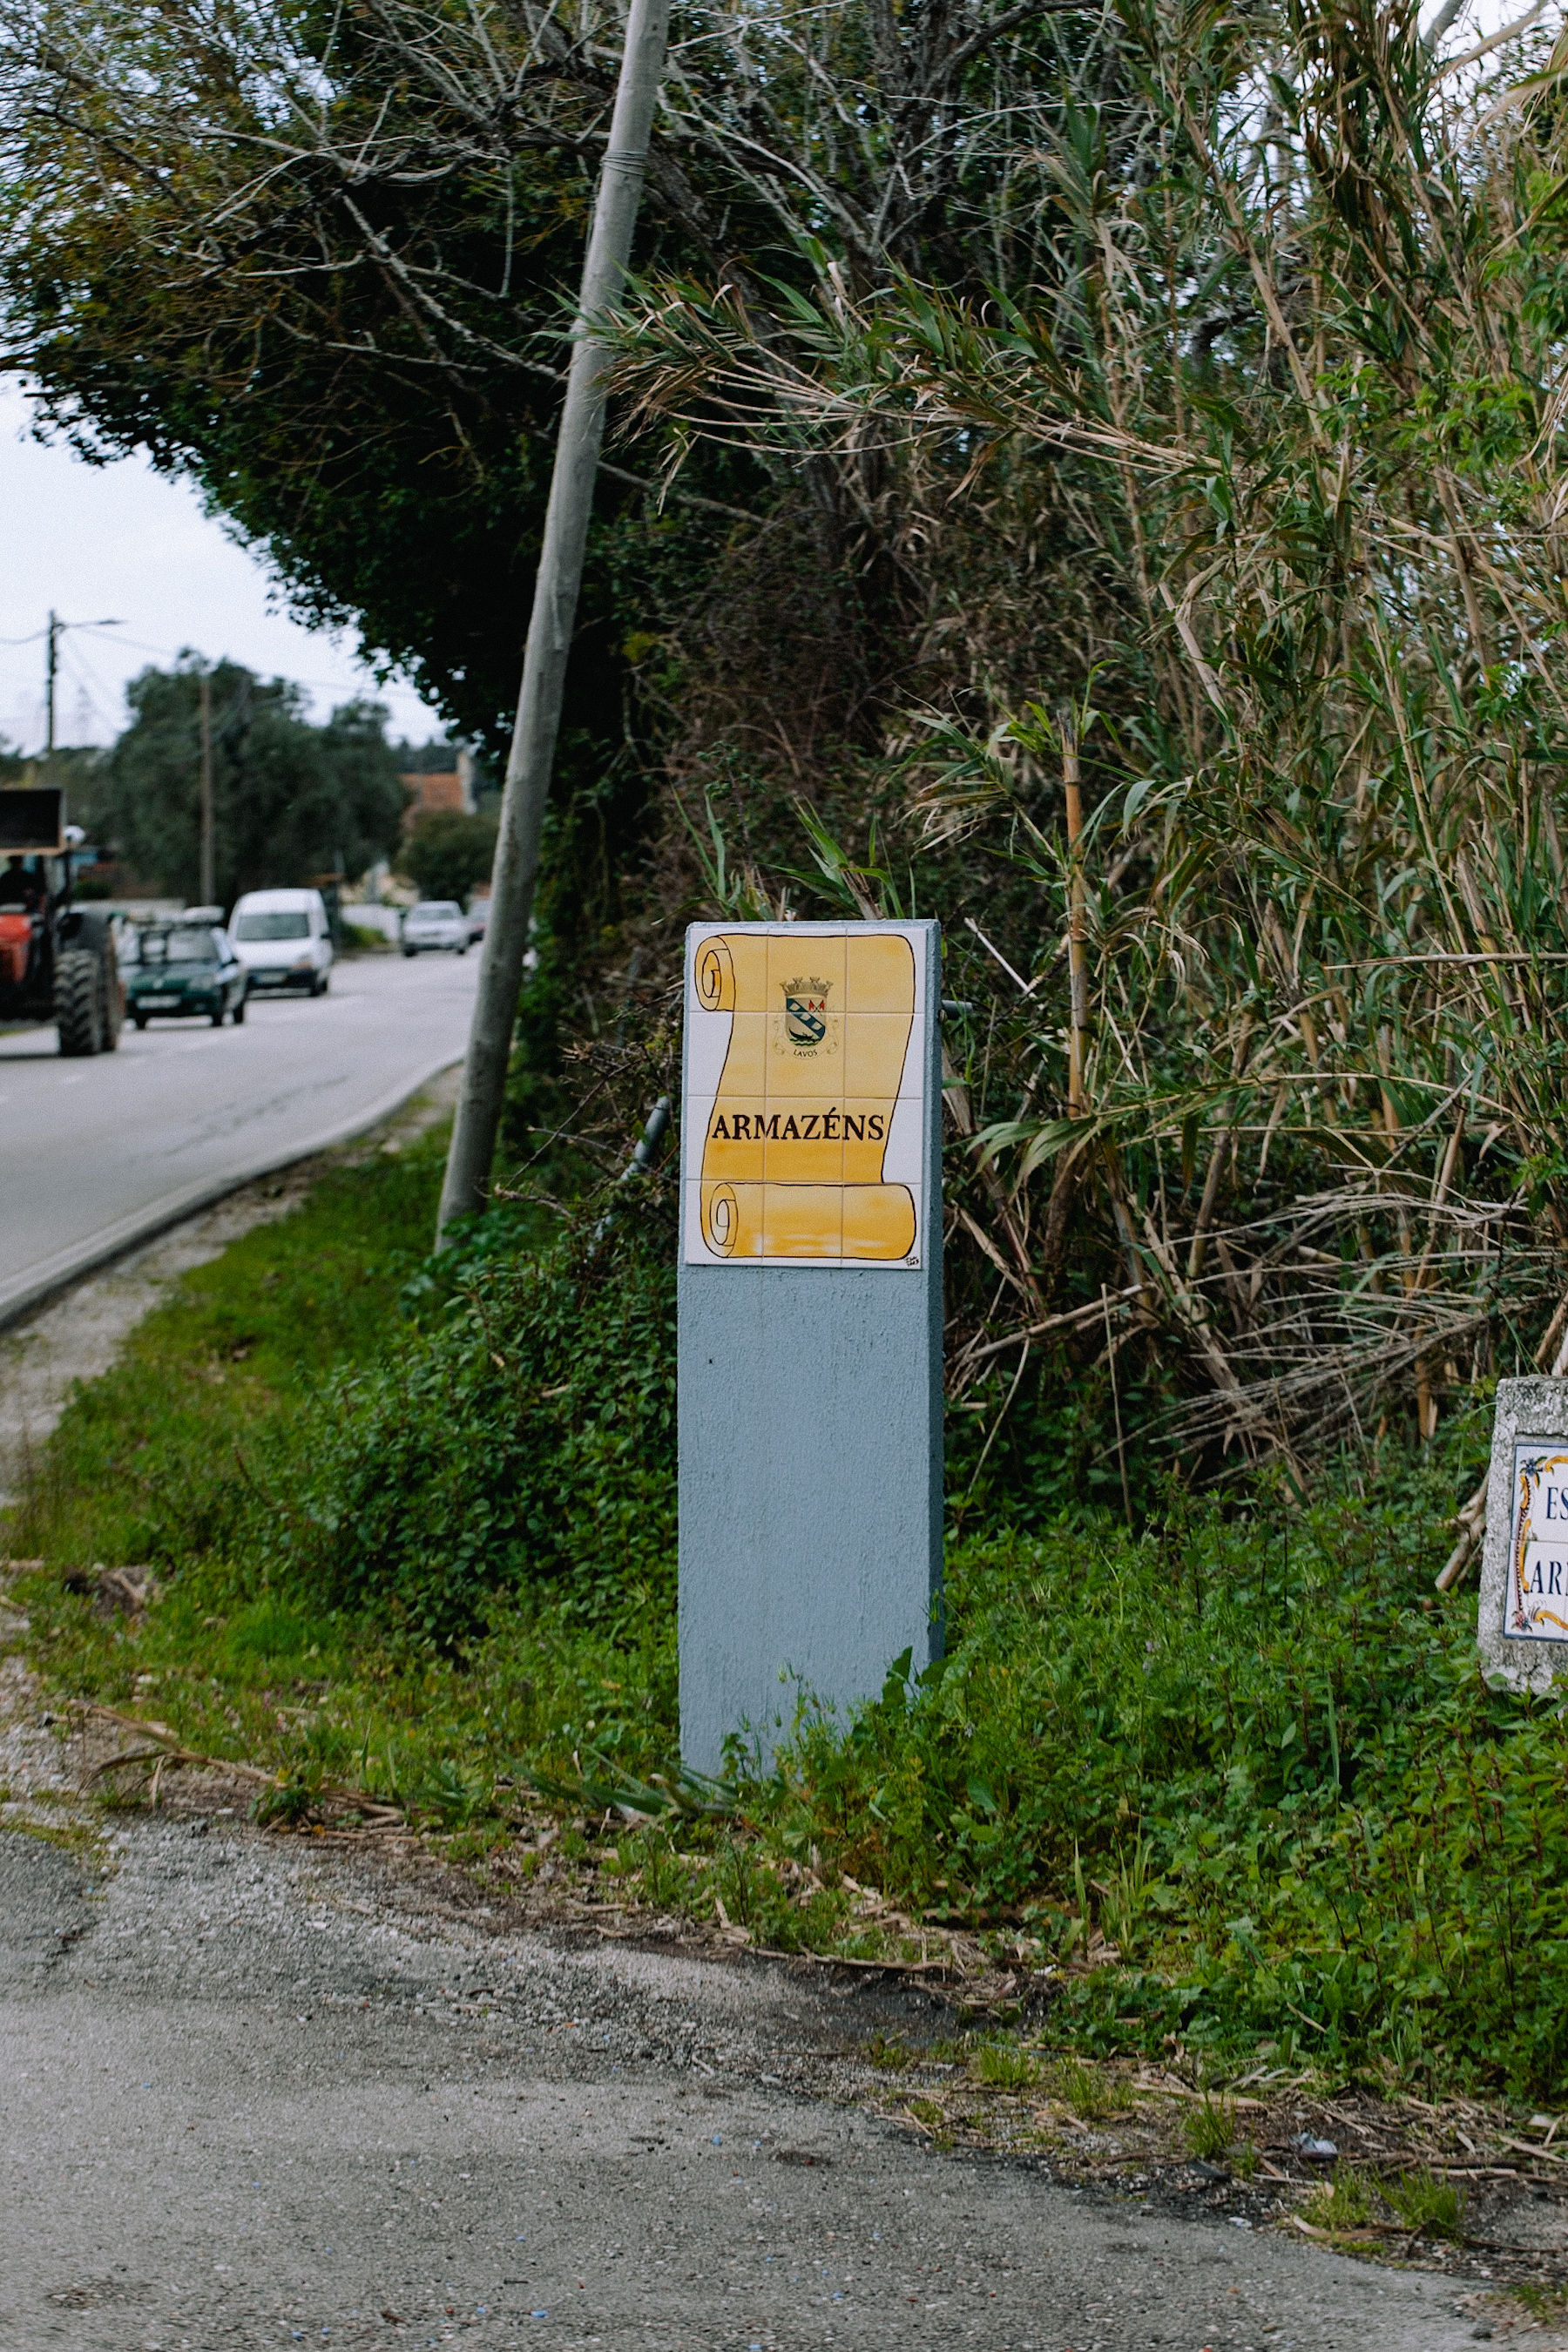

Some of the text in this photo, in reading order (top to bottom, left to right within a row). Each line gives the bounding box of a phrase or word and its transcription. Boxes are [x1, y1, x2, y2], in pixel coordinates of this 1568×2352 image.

[793, 1049, 818, 1058] LAVOS
[711, 1106, 884, 1141] ARMAZÉNS
[1530, 1560, 1568, 1596] AR
